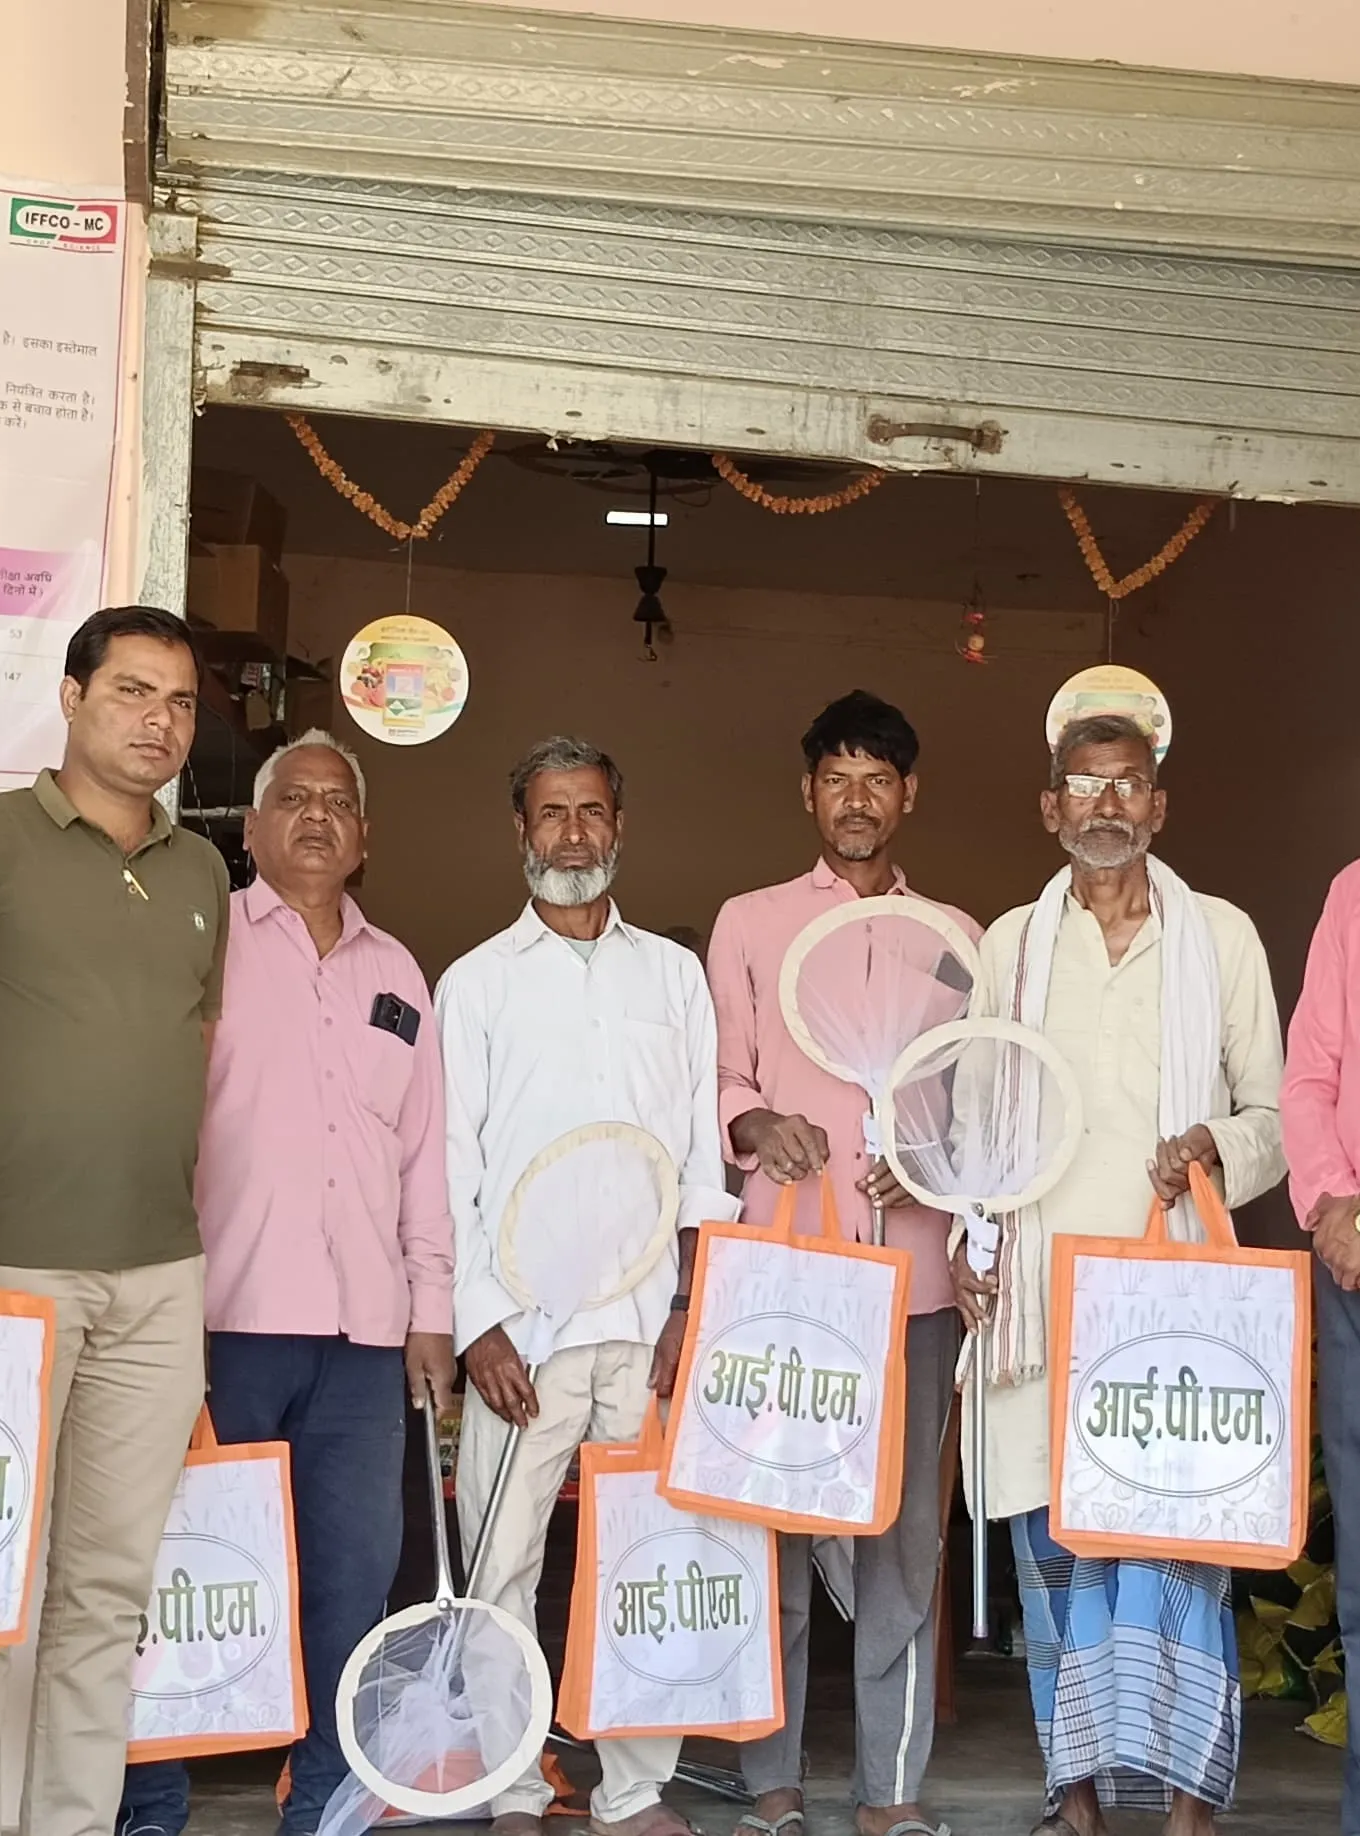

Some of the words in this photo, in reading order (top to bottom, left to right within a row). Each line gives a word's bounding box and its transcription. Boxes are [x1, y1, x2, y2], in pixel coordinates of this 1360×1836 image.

[25, 211, 70, 230] IFFCO
[84, 217, 104, 232] MC
[9, 629, 23, 641] 53
[4, 670, 23, 682] 147
